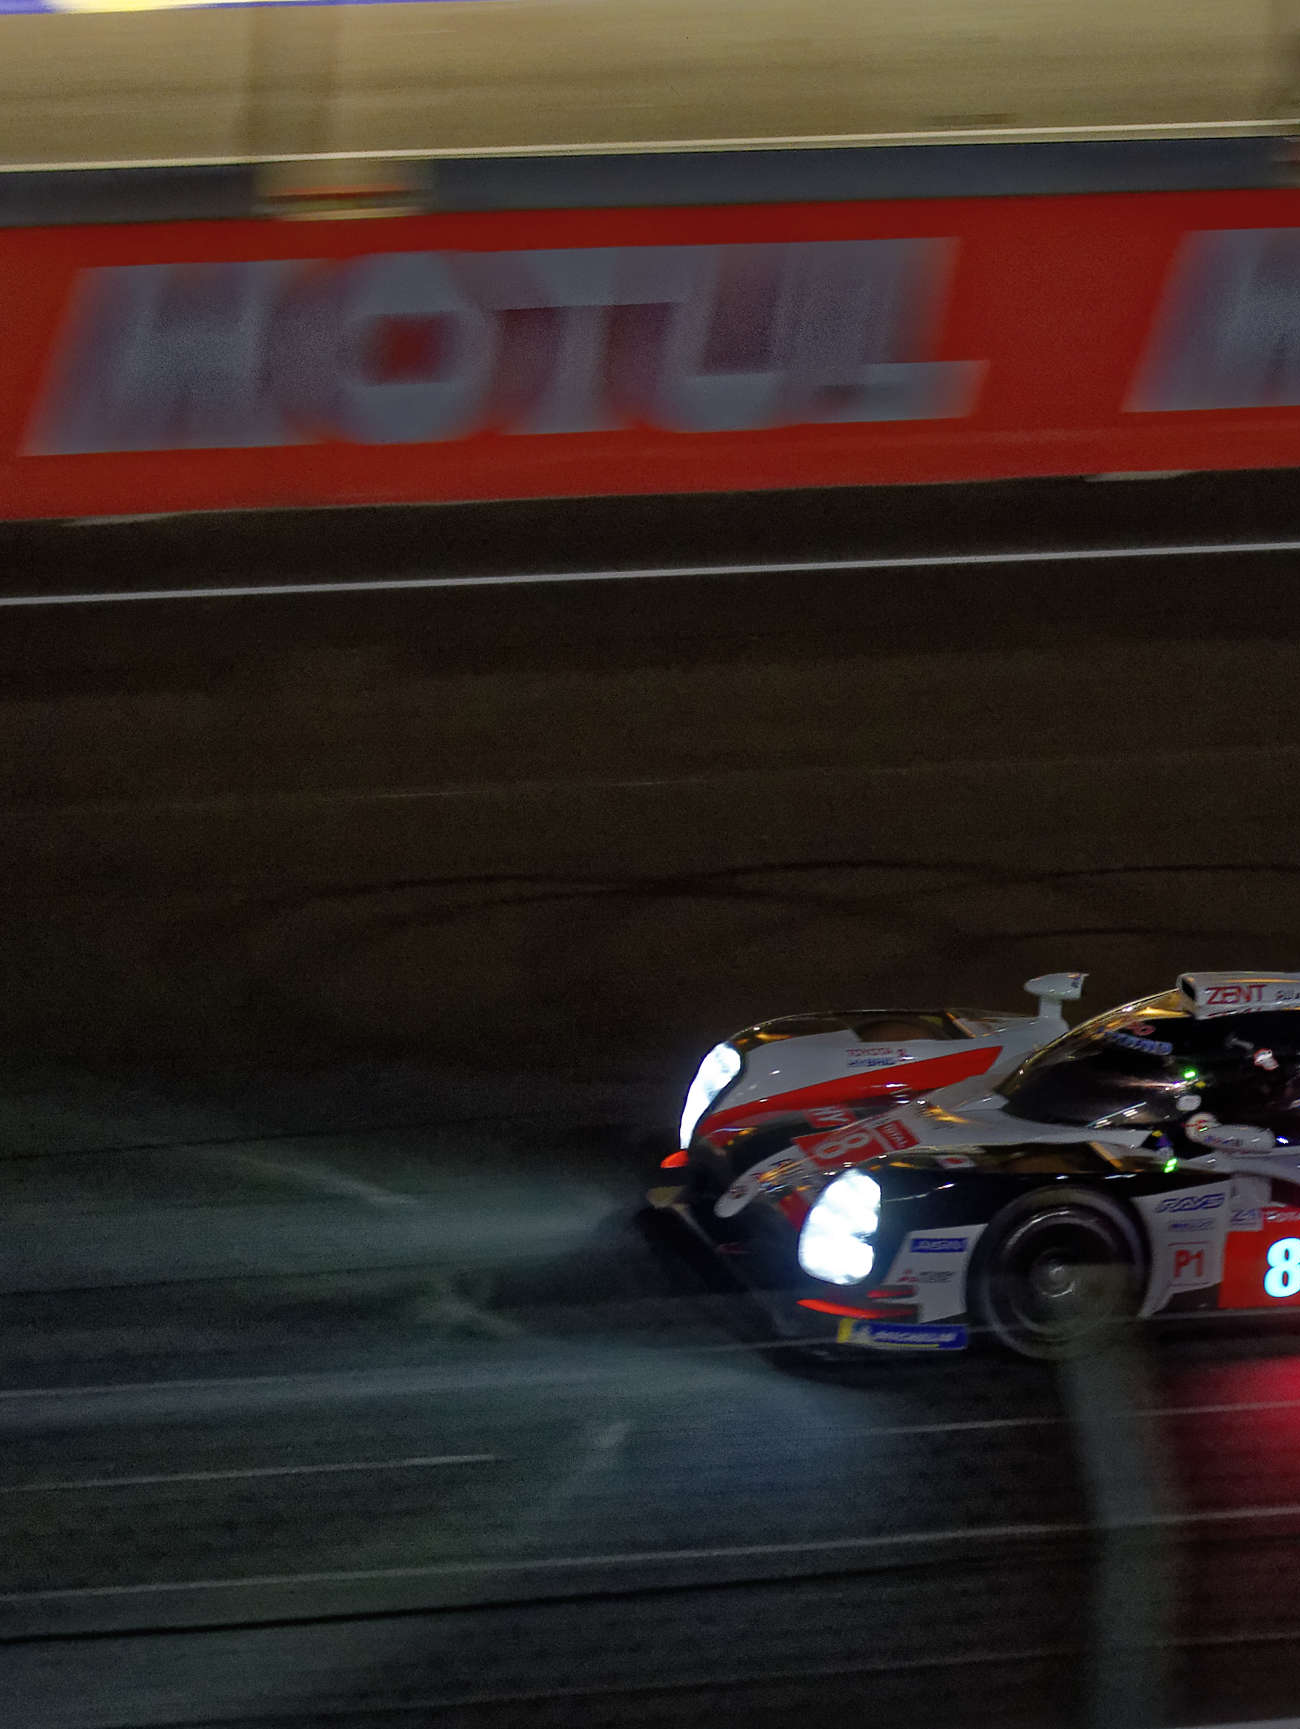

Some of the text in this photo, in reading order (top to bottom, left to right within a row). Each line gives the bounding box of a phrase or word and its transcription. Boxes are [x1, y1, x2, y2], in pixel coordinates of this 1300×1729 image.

[18, 236, 990, 458] MOTUL
[1206, 984, 1266, 1005] ZENT
[814, 1130, 872, 1160] 8
[1174, 1249, 1205, 1277] P1
